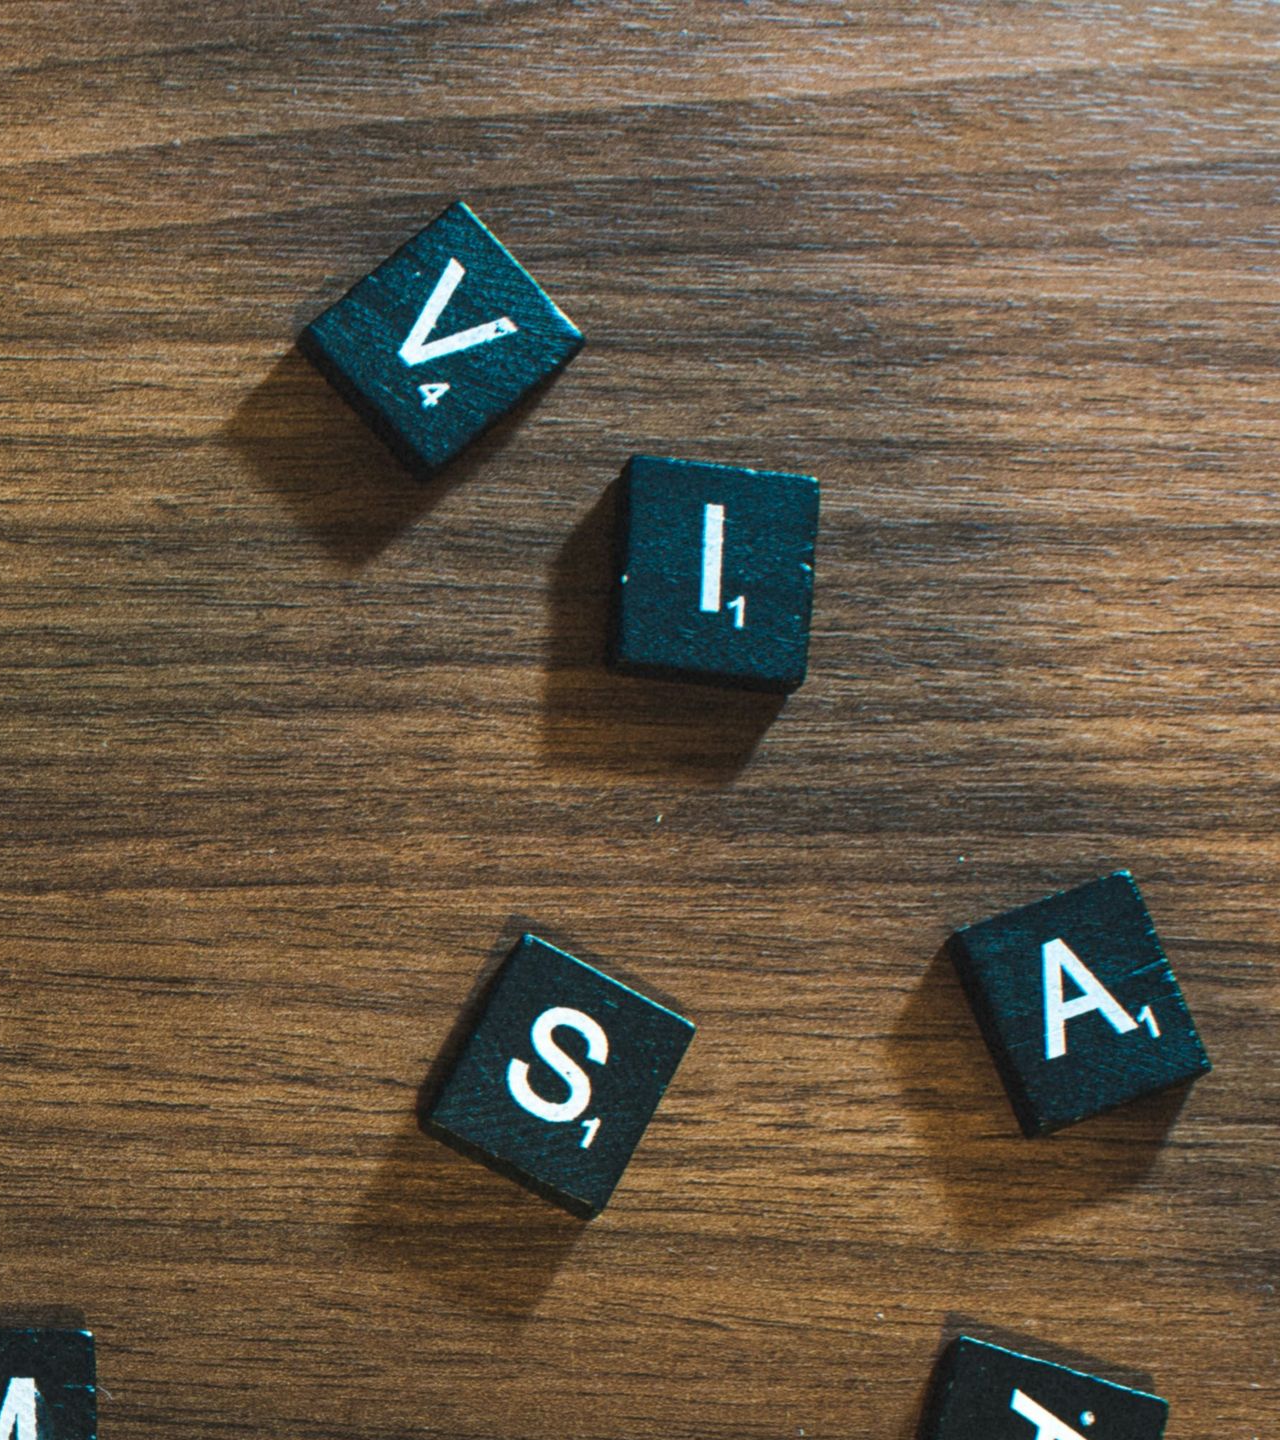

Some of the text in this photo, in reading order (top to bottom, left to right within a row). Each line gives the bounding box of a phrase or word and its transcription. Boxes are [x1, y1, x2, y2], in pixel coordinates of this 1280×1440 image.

[400, 256, 519, 365] V
[420, 382, 450, 405] 4
[702, 503, 725, 612] I
[729, 594, 745, 627] 1
[1044, 937, 1133, 1059] A
[1140, 1005, 1160, 1037] 1
[508, 1006, 608, 1122] S
[582, 1118, 601, 1149] 1
